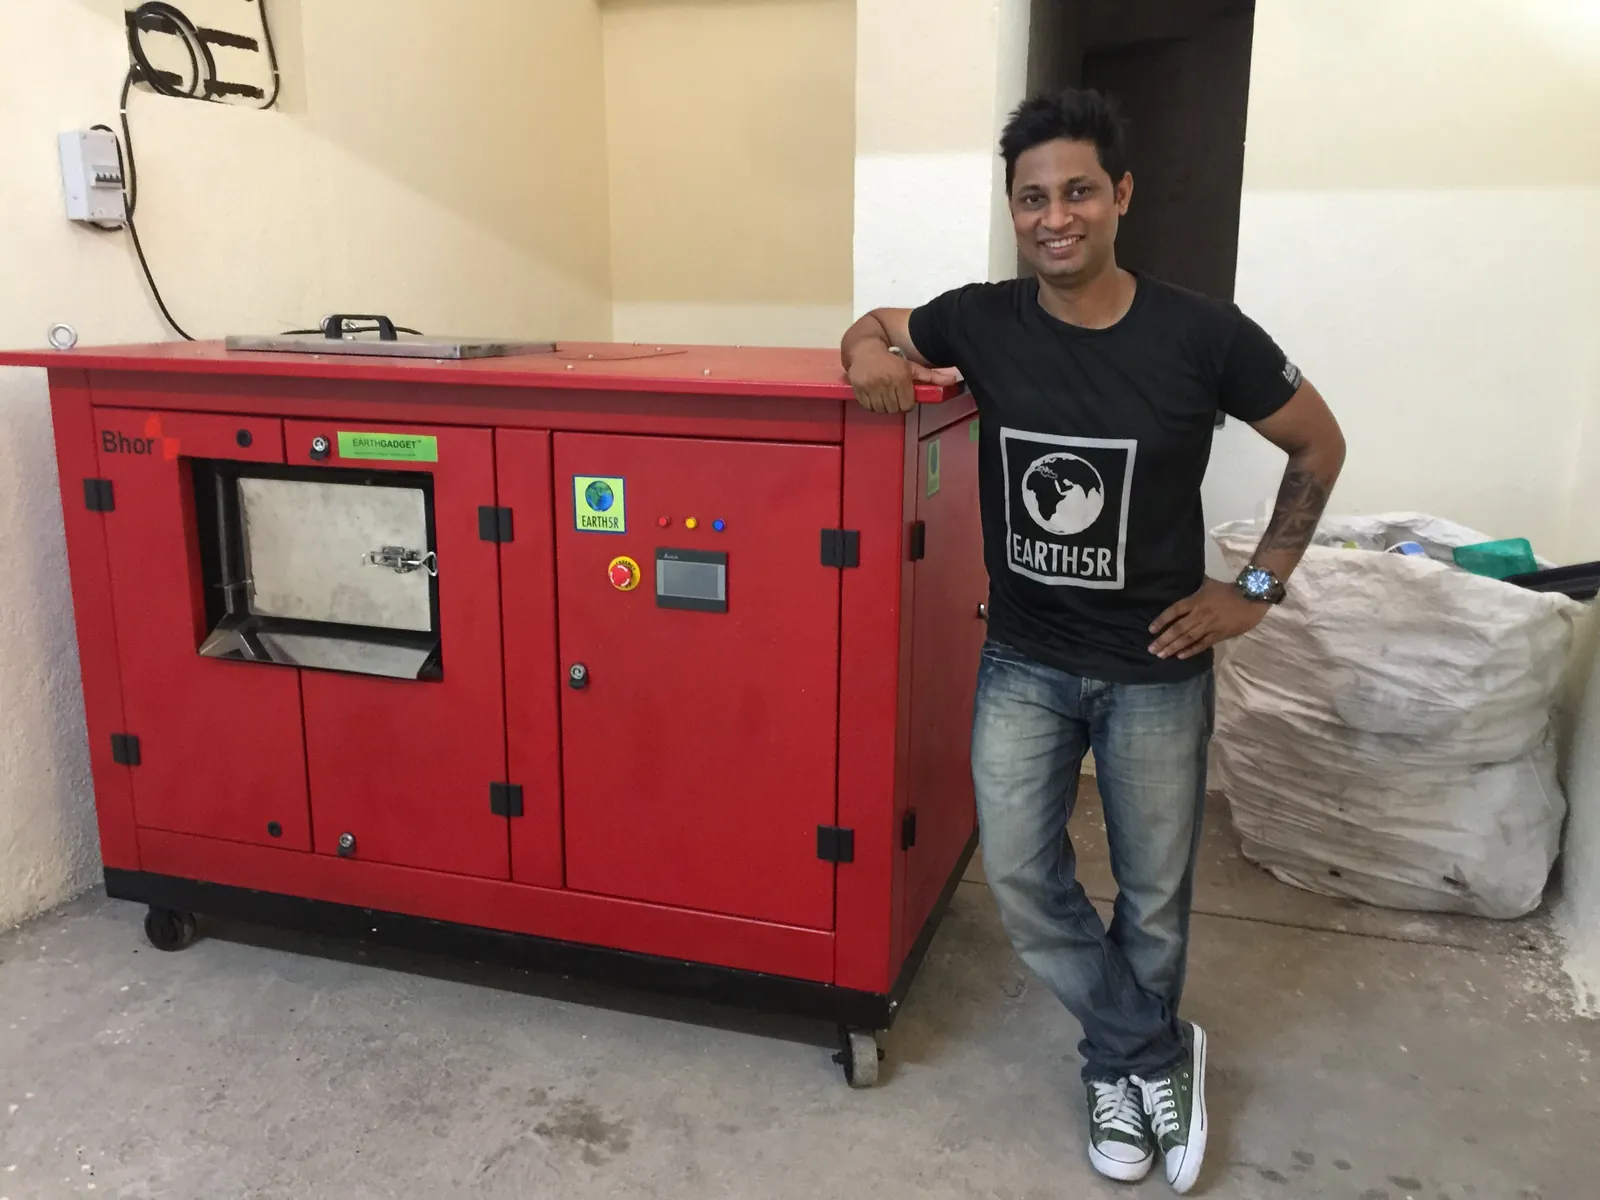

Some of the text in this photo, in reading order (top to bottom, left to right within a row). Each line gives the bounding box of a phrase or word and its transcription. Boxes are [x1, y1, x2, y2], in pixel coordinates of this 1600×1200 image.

[102, 430, 155, 455] Bhor
[581, 515, 619, 529] EARTH5R
[1013, 534, 1111, 577] EARTH5R
